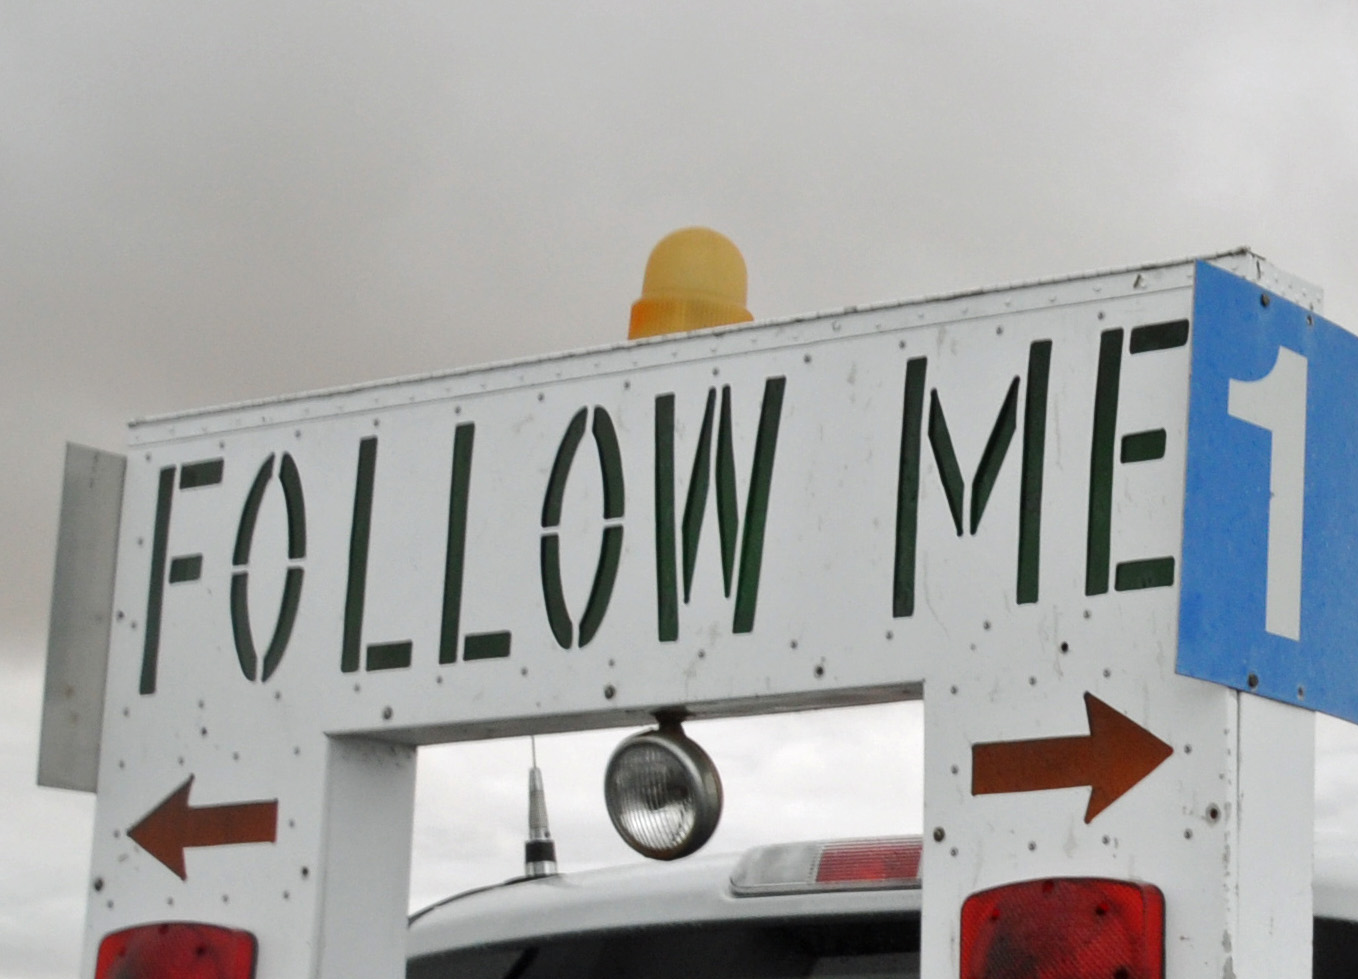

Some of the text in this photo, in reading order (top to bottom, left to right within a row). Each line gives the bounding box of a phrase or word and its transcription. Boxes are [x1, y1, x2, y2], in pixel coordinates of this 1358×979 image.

[138, 318, 1190, 695] FOLLOW ME
[1227, 344, 1309, 642] 1
